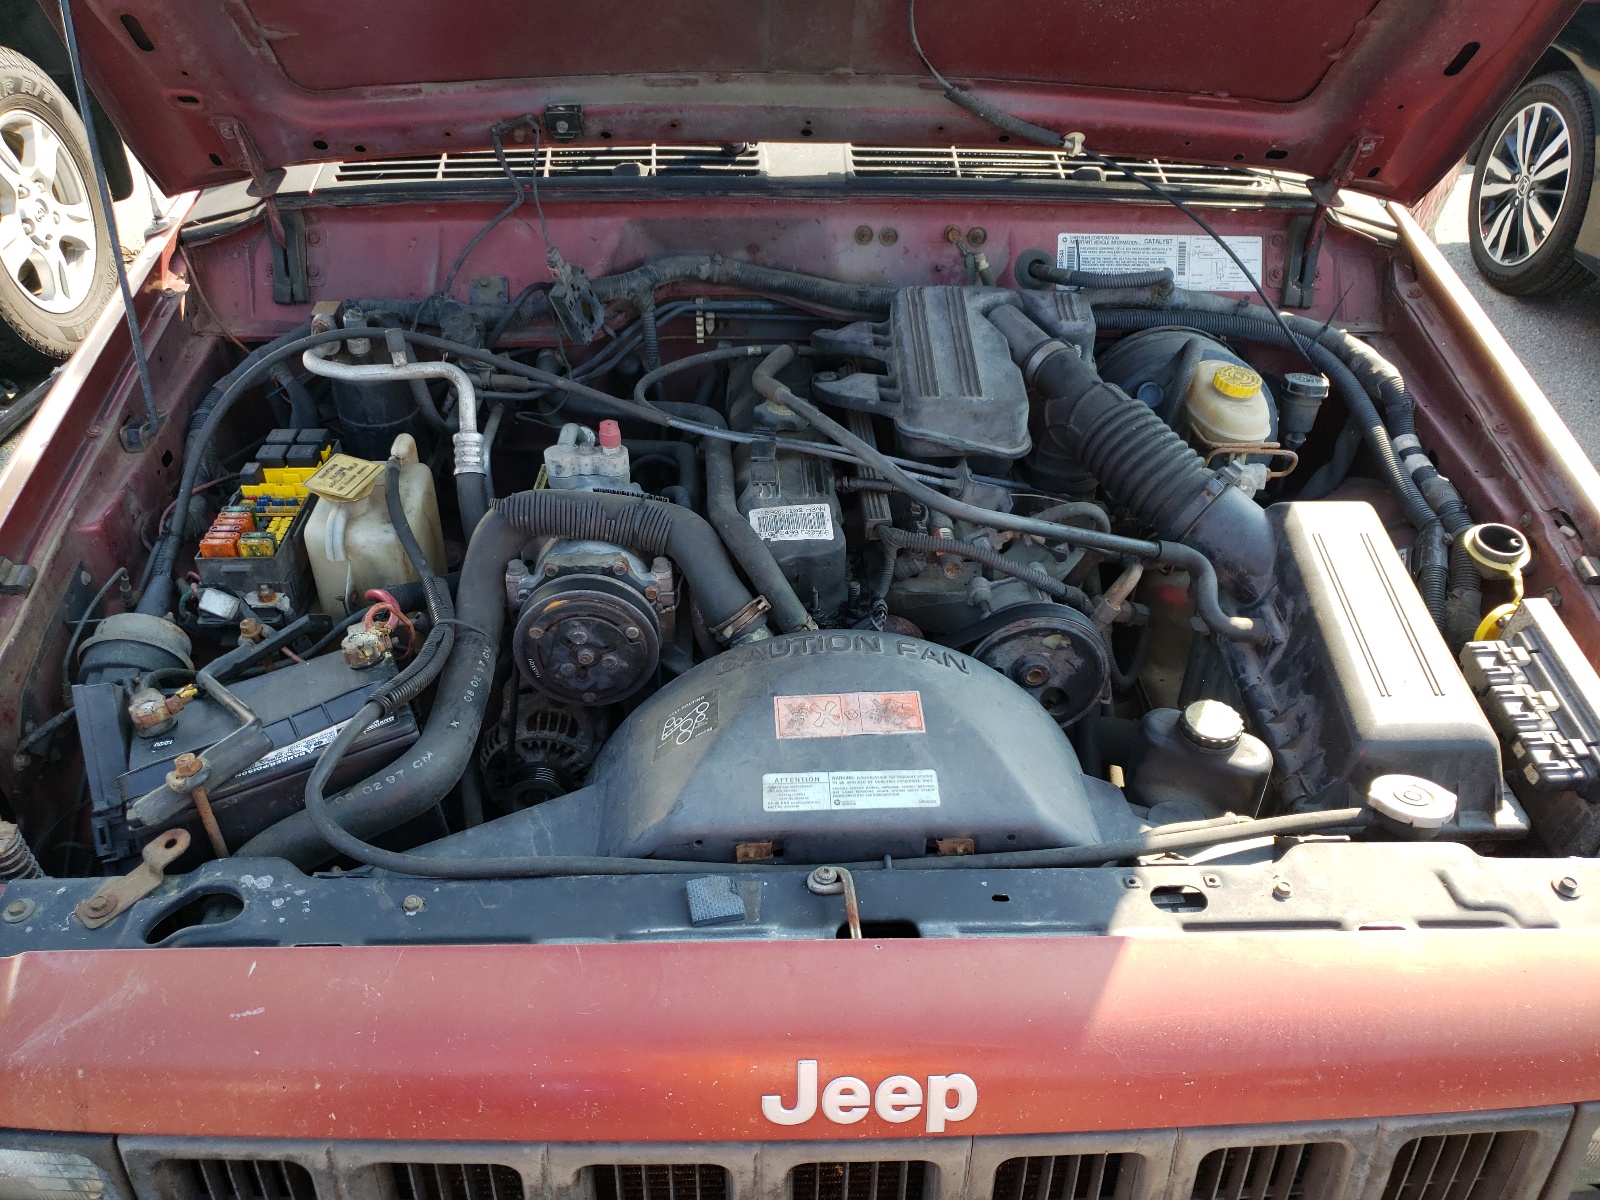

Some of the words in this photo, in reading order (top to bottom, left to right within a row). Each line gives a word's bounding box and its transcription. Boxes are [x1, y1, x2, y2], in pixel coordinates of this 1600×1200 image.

[715, 634, 883, 675] CAUTION
[897, 639, 970, 675] FAN
[362, 781, 384, 795] 02
[385, 769, 405, 784] 97
[412, 751, 434, 768] CM
[761, 1059, 978, 1133] Jeep
